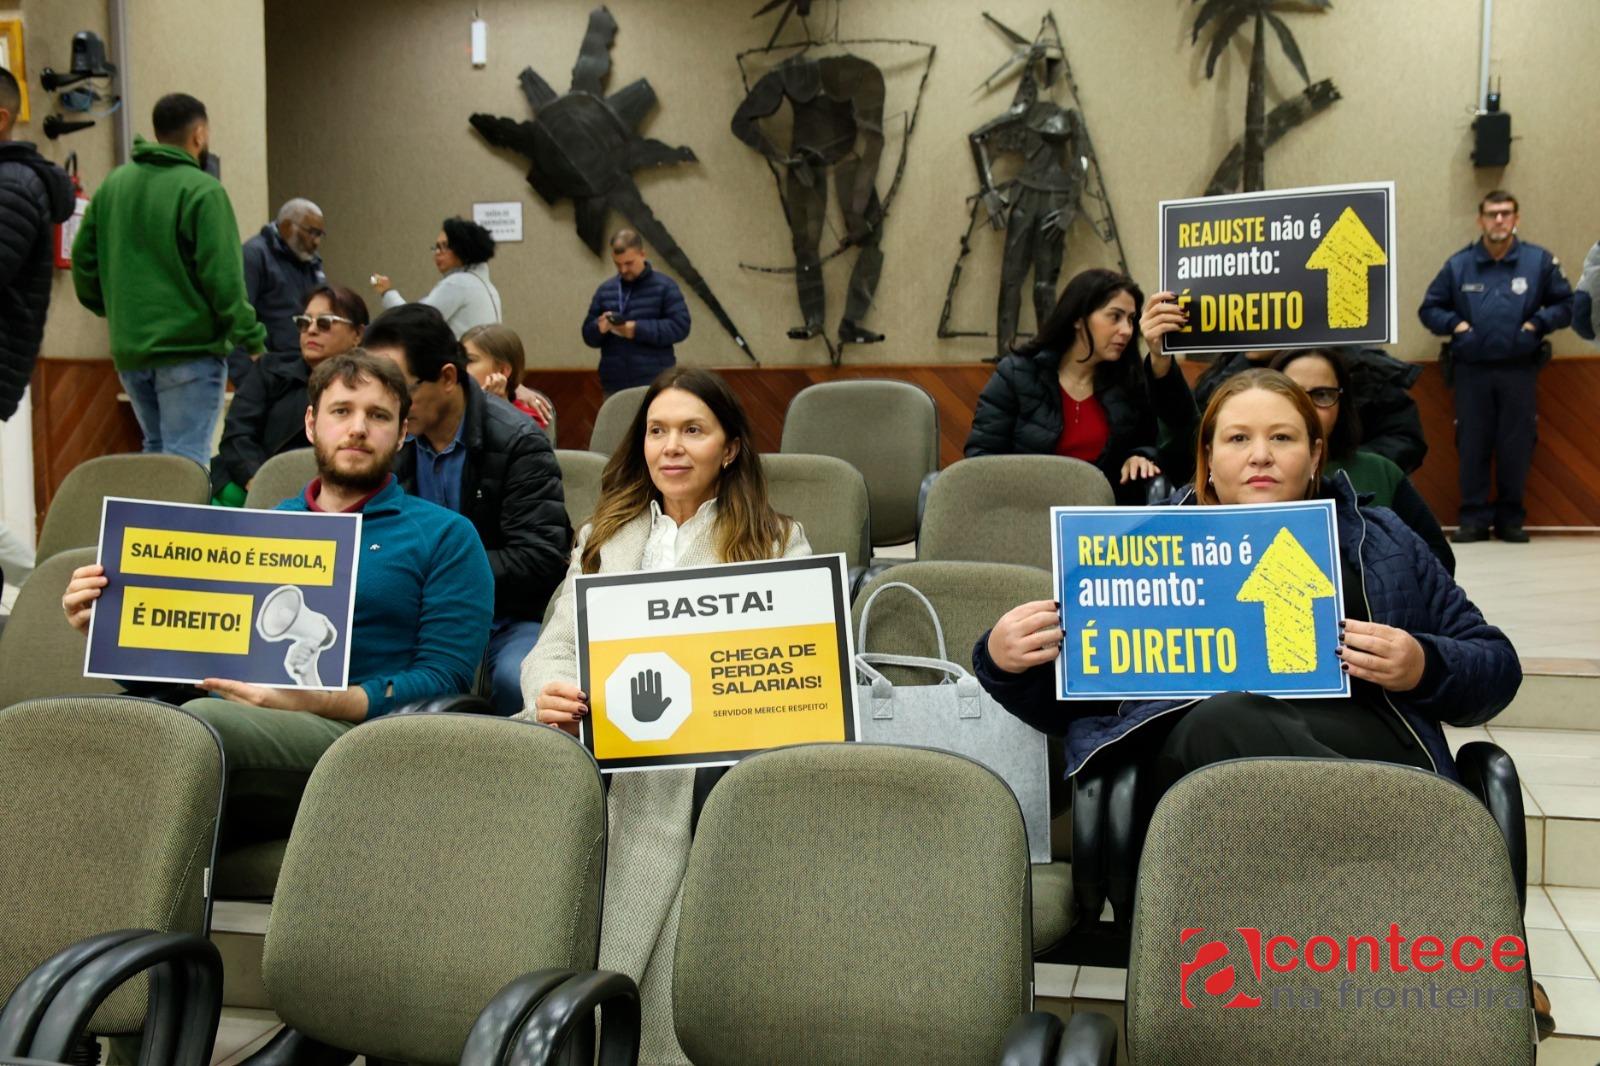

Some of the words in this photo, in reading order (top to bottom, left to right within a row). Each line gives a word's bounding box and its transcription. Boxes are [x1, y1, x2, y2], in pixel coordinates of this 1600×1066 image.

[1178, 216, 1265, 249] REAJUSTE
[1270, 215, 1305, 242] não
[1309, 213, 1322, 240] é
[1177, 246, 1280, 280] aumento:
[1177, 288, 1193, 333] É
[1200, 291, 1304, 332] DIREITO
[131, 542, 202, 562] SALÁRIO
[207, 546, 241, 565] NÃO
[245, 547, 255, 566] É
[259, 551, 327, 573] ESMOLA,
[1078, 535, 1185, 567] REAJUSTE
[1191, 535, 1232, 567] não
[1239, 534, 1253, 566] é
[1079, 572, 1206, 607] aumento:
[132, 602, 147, 626] É
[151, 606, 242, 632] DIREITO!
[647, 590, 774, 621] BASTA!
[710, 646, 784, 663] CHEGA
[788, 643, 817, 658] DE
[1081, 620, 1100, 675] É
[1109, 627, 1237, 675] DIREITO
[711, 661, 794, 680] PERDAS
[712, 675, 823, 696] SALARIAIS!
[713, 708, 753, 718] SERVIDOR
[754, 705, 787, 715] MERECE
[788, 702, 829, 713] RESPEITO!
